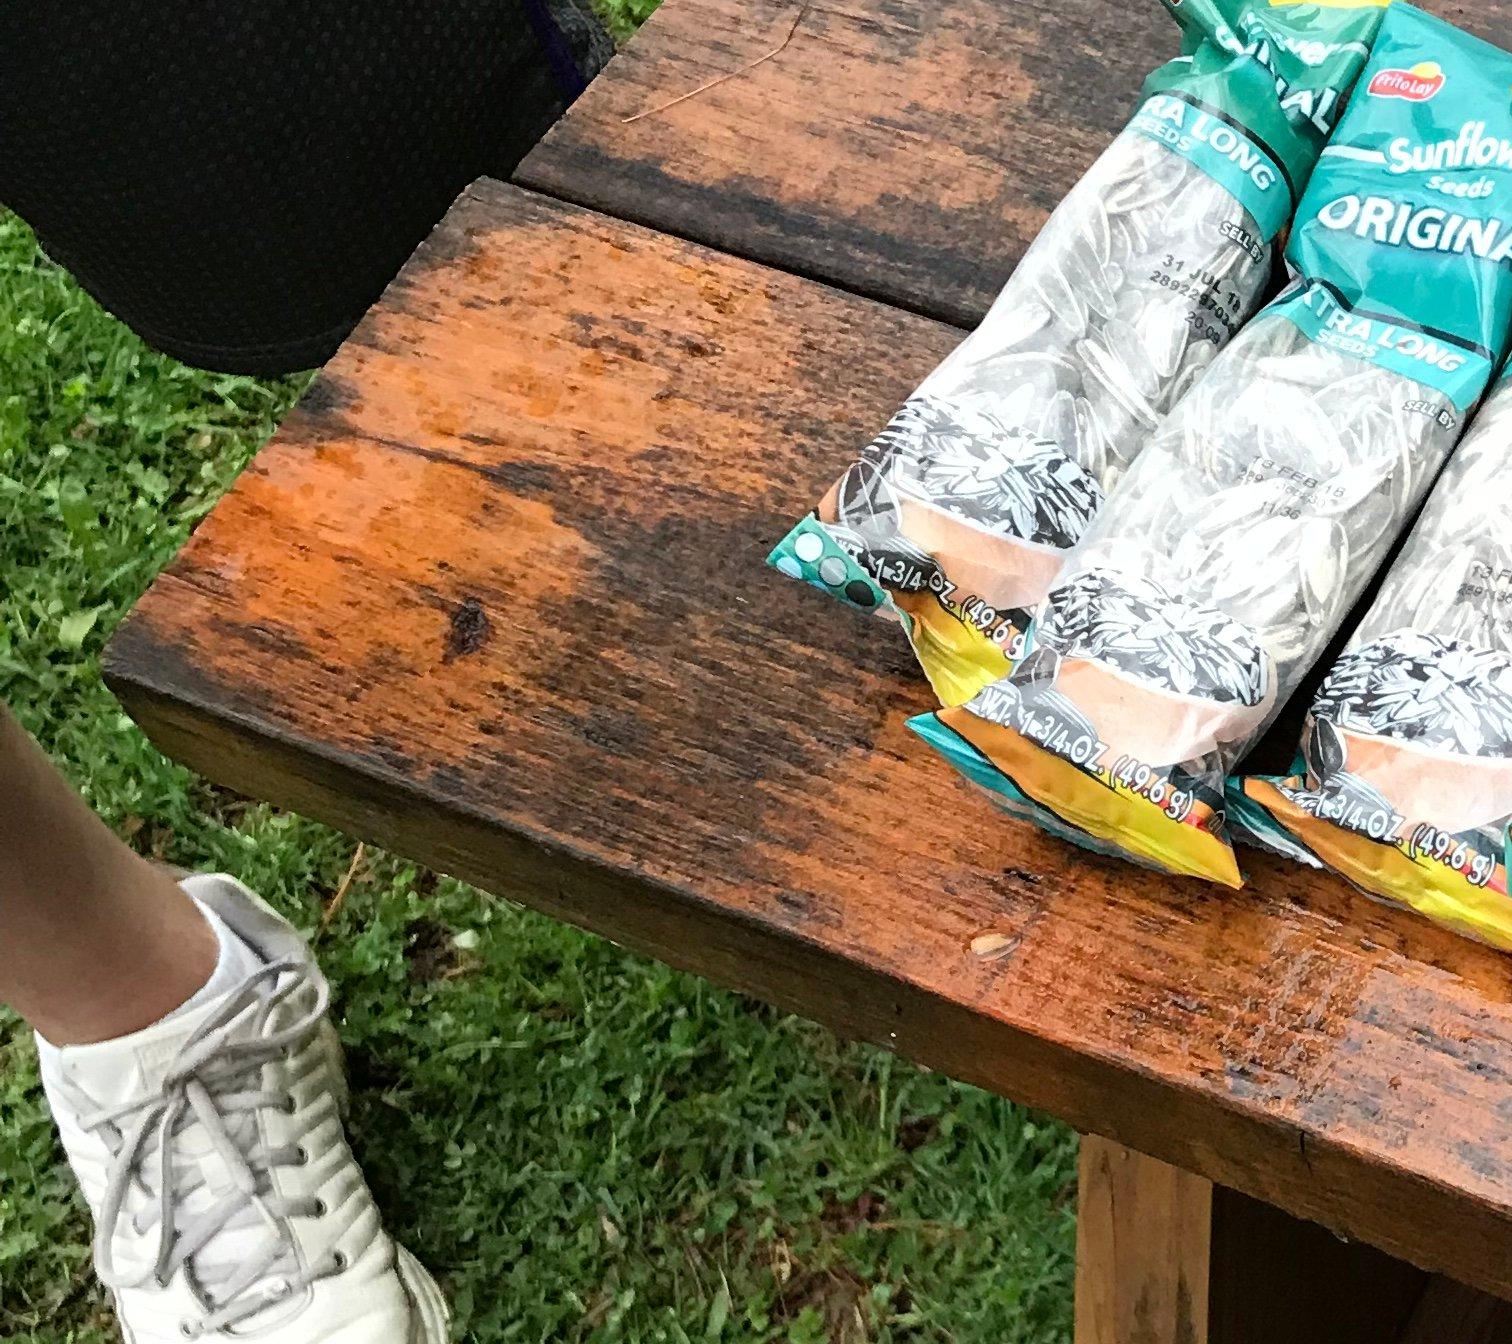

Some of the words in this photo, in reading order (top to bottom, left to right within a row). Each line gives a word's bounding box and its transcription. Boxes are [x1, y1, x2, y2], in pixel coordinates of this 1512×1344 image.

[1140, 117, 1193, 152] EEDS
[1191, 112, 1276, 190] LONG
[1219, 221, 1251, 250] SELL
[1162, 254, 1184, 272] 31
[1189, 268, 1222, 295] JUL
[1303, 283, 1373, 342] XTRA
[1376, 326, 1467, 373] LONG
[1403, 400, 1436, 419] SELL
[1436, 408, 1456, 431] BY
[960, 595, 1012, 644] (49.6
[1110, 754, 1168, 803] (49.6
[1409, 822, 1467, 870] (49.6
